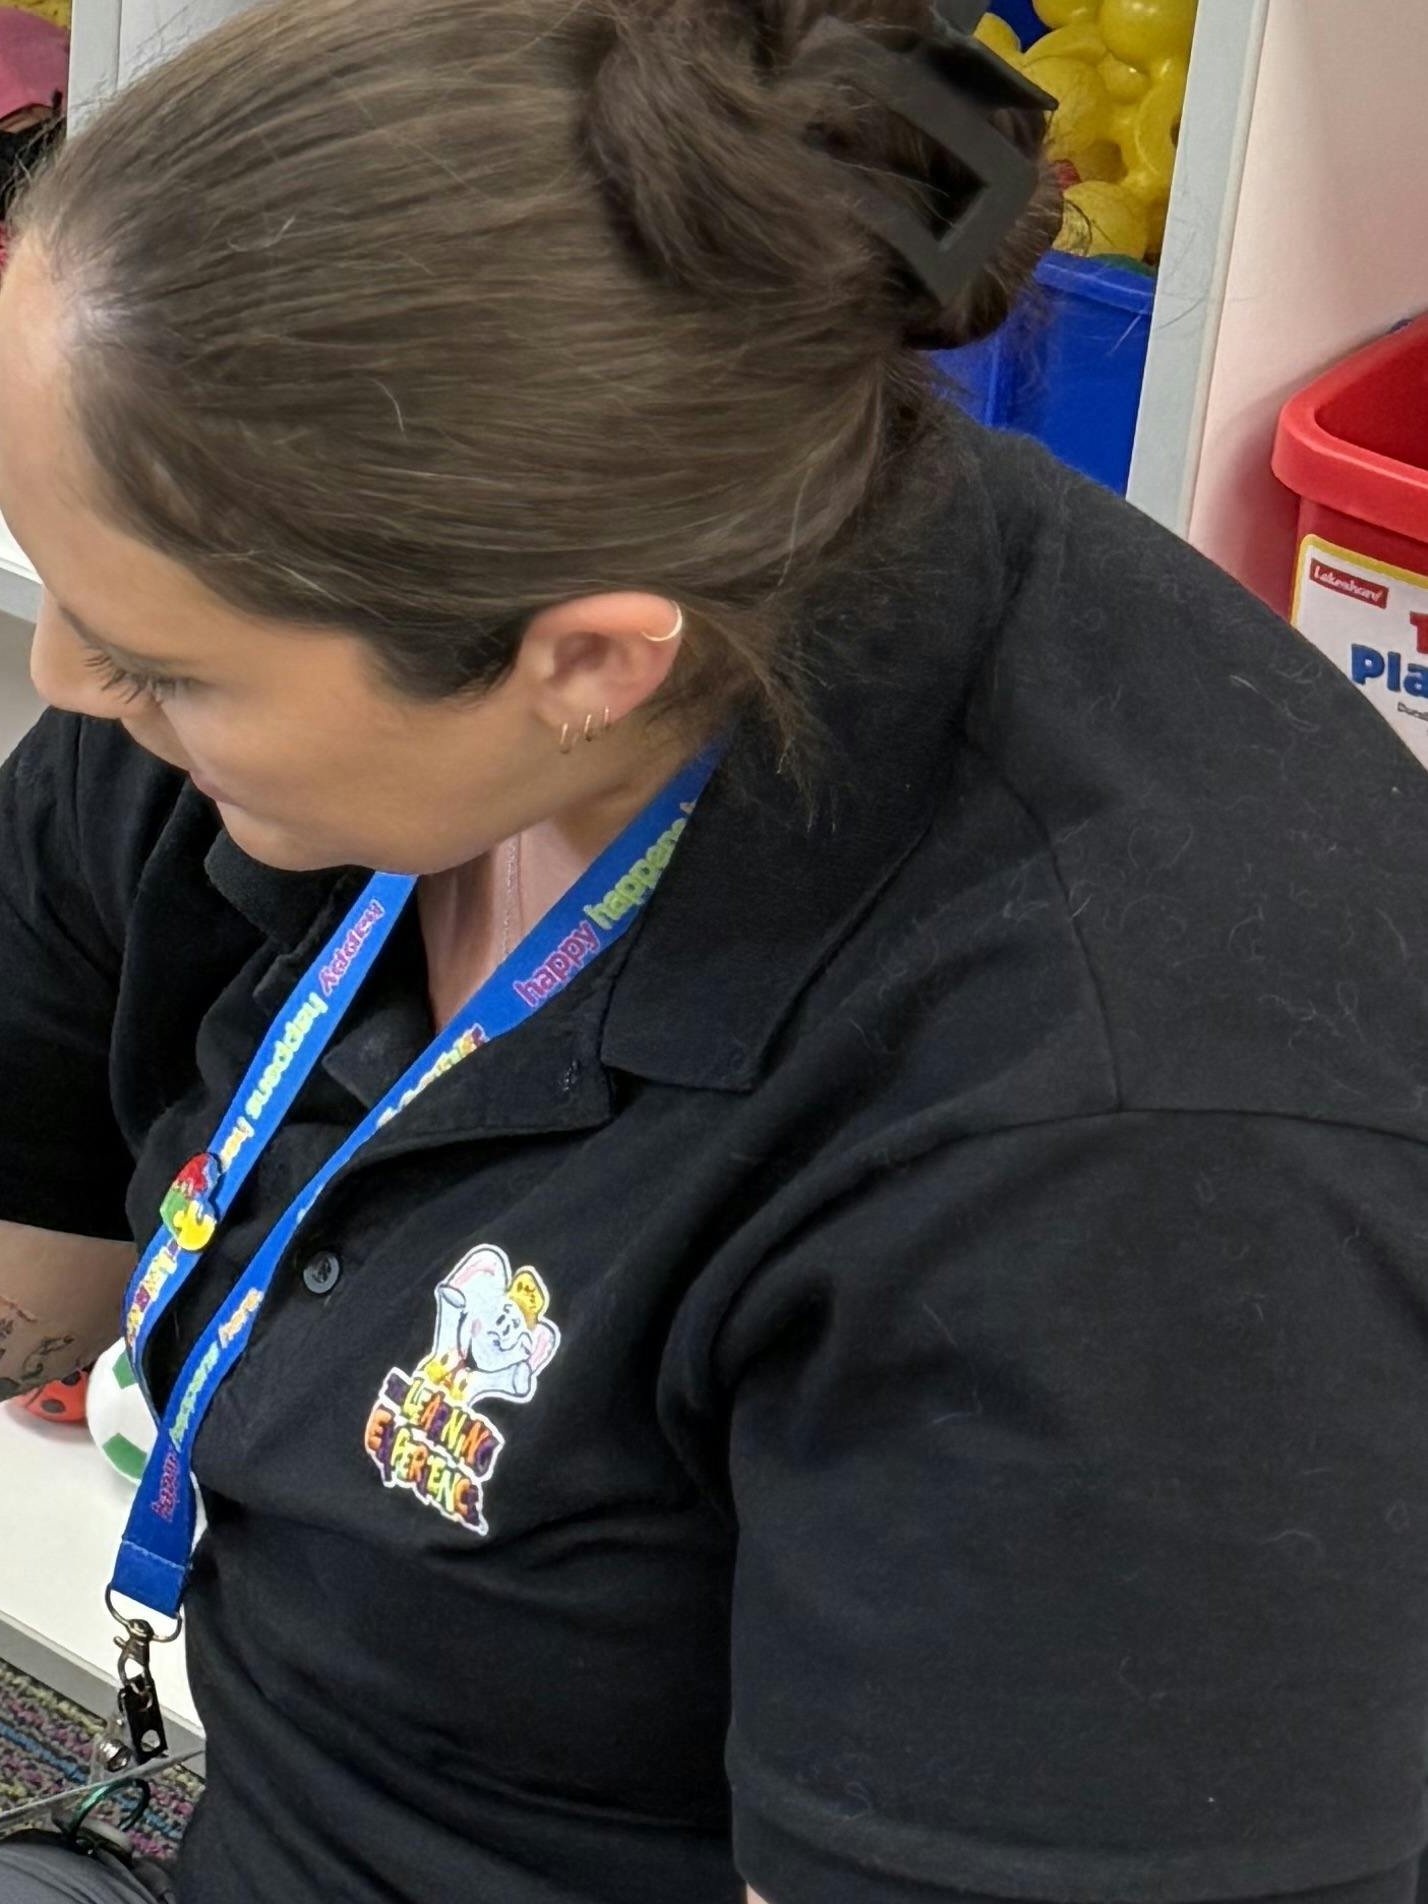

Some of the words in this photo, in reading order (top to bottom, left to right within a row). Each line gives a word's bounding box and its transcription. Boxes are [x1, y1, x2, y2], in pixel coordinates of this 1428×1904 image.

[318, 899, 385, 996] happy
[513, 920, 601, 1008] happy
[245, 992, 328, 1120] happens
